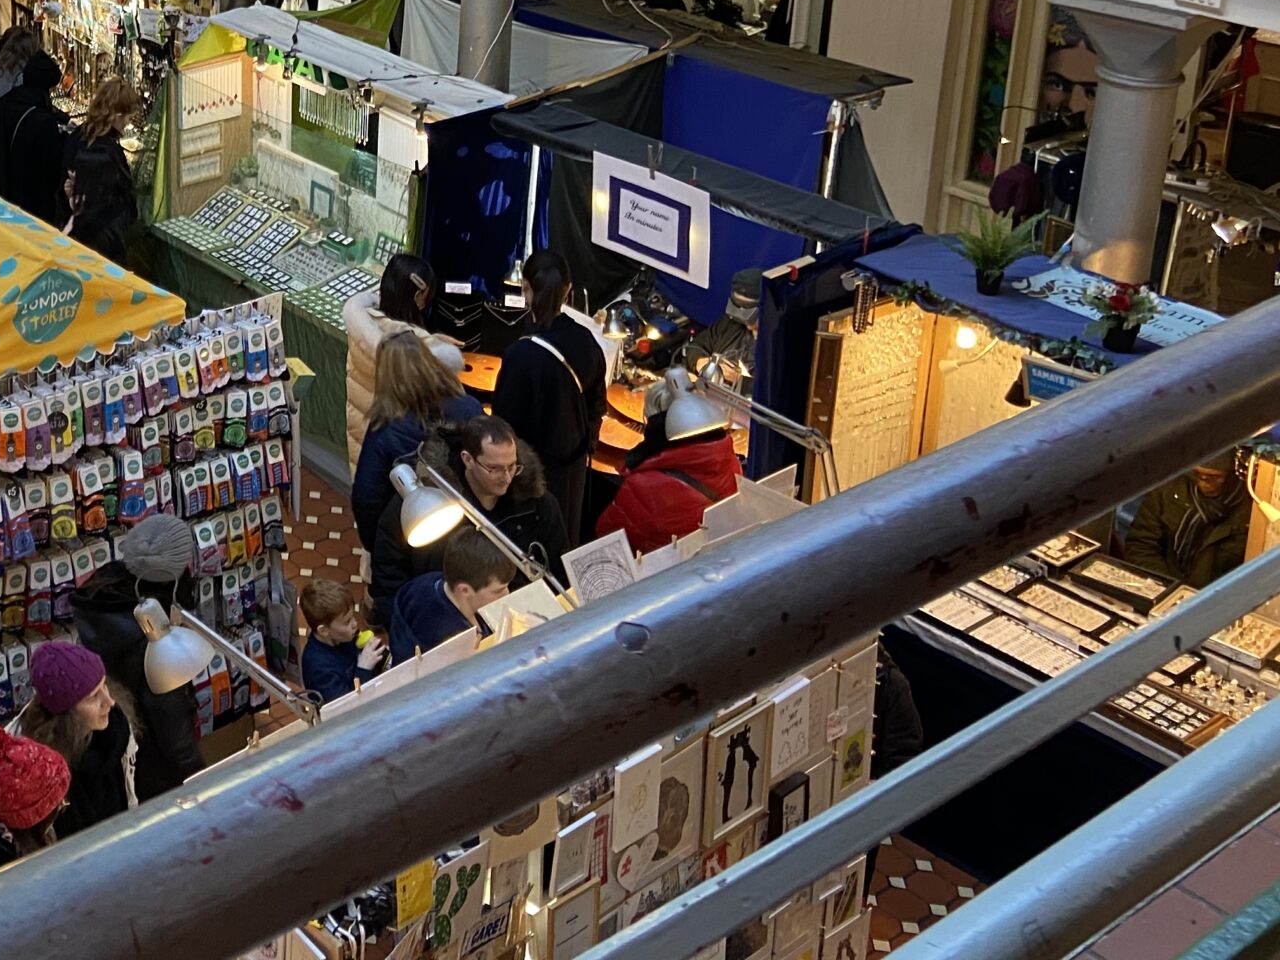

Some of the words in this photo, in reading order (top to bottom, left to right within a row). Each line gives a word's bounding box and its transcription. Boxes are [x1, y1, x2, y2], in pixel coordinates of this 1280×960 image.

[629, 199, 650, 212] Your
[650, 210, 670, 221] name
[635, 218, 663, 233] minutes
[40, 275, 63, 291] the
[20, 288, 79, 315] LONDON
[20, 302, 79, 334] STORIES
